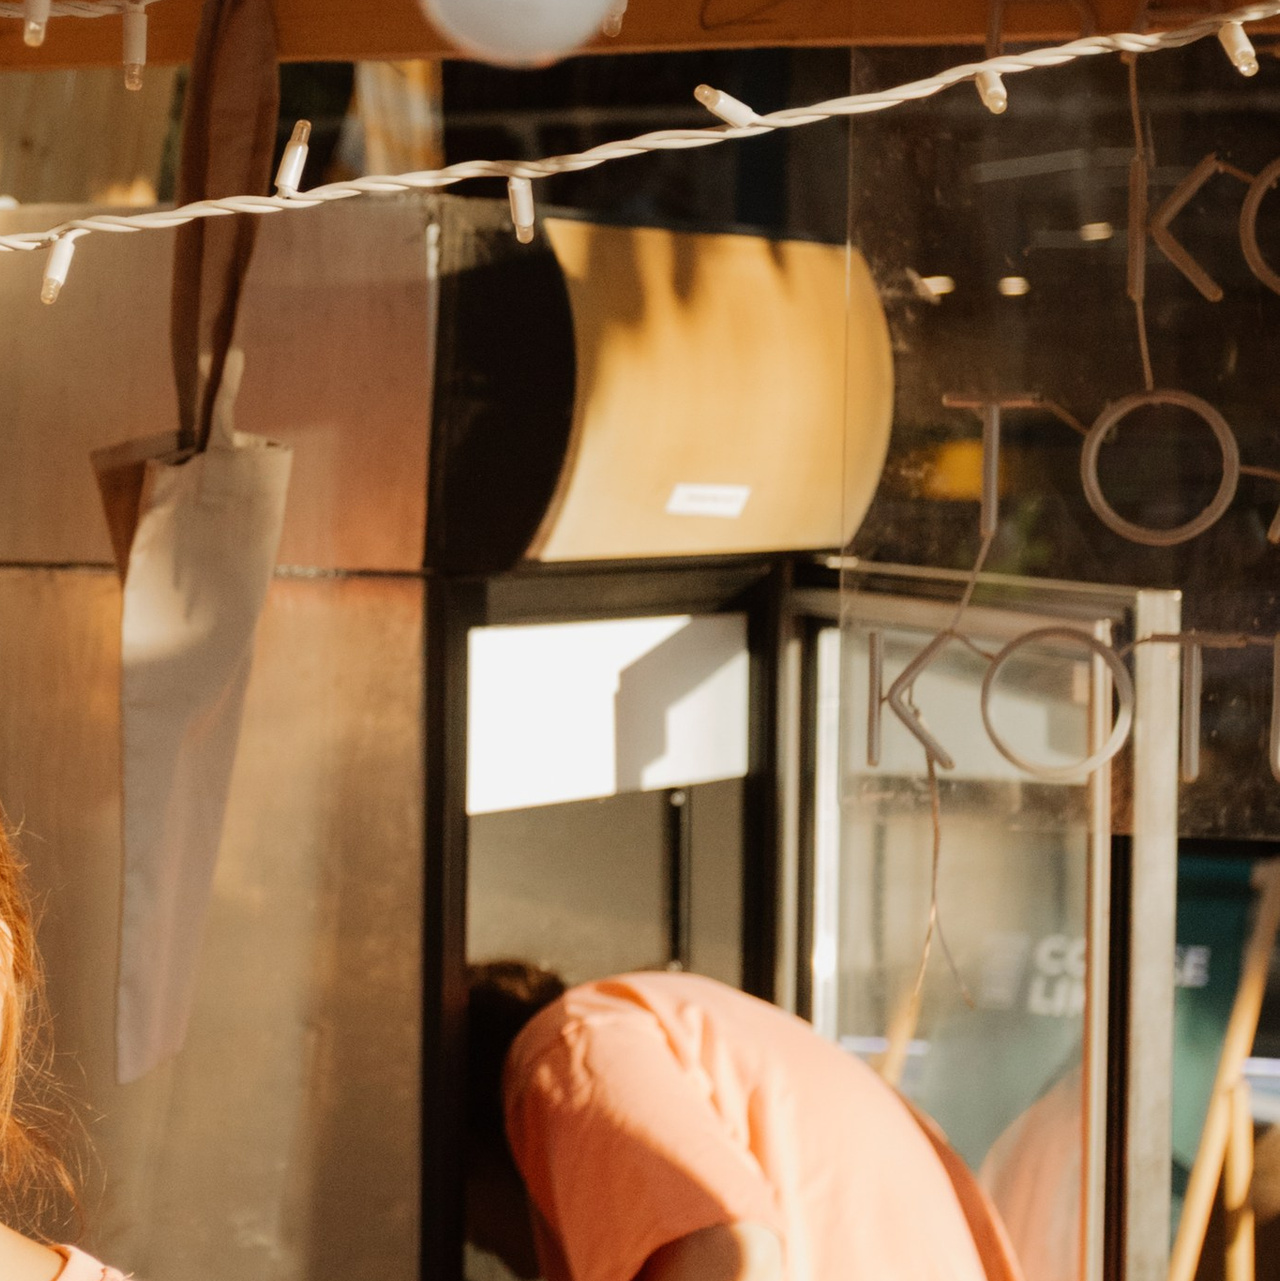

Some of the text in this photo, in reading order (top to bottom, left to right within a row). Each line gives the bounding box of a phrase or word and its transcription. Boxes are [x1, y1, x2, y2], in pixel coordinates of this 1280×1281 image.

[1126, 150, 1280, 303] К
[942, 388, 1280, 547] ТО
[867, 627, 1280, 784] КОТ
